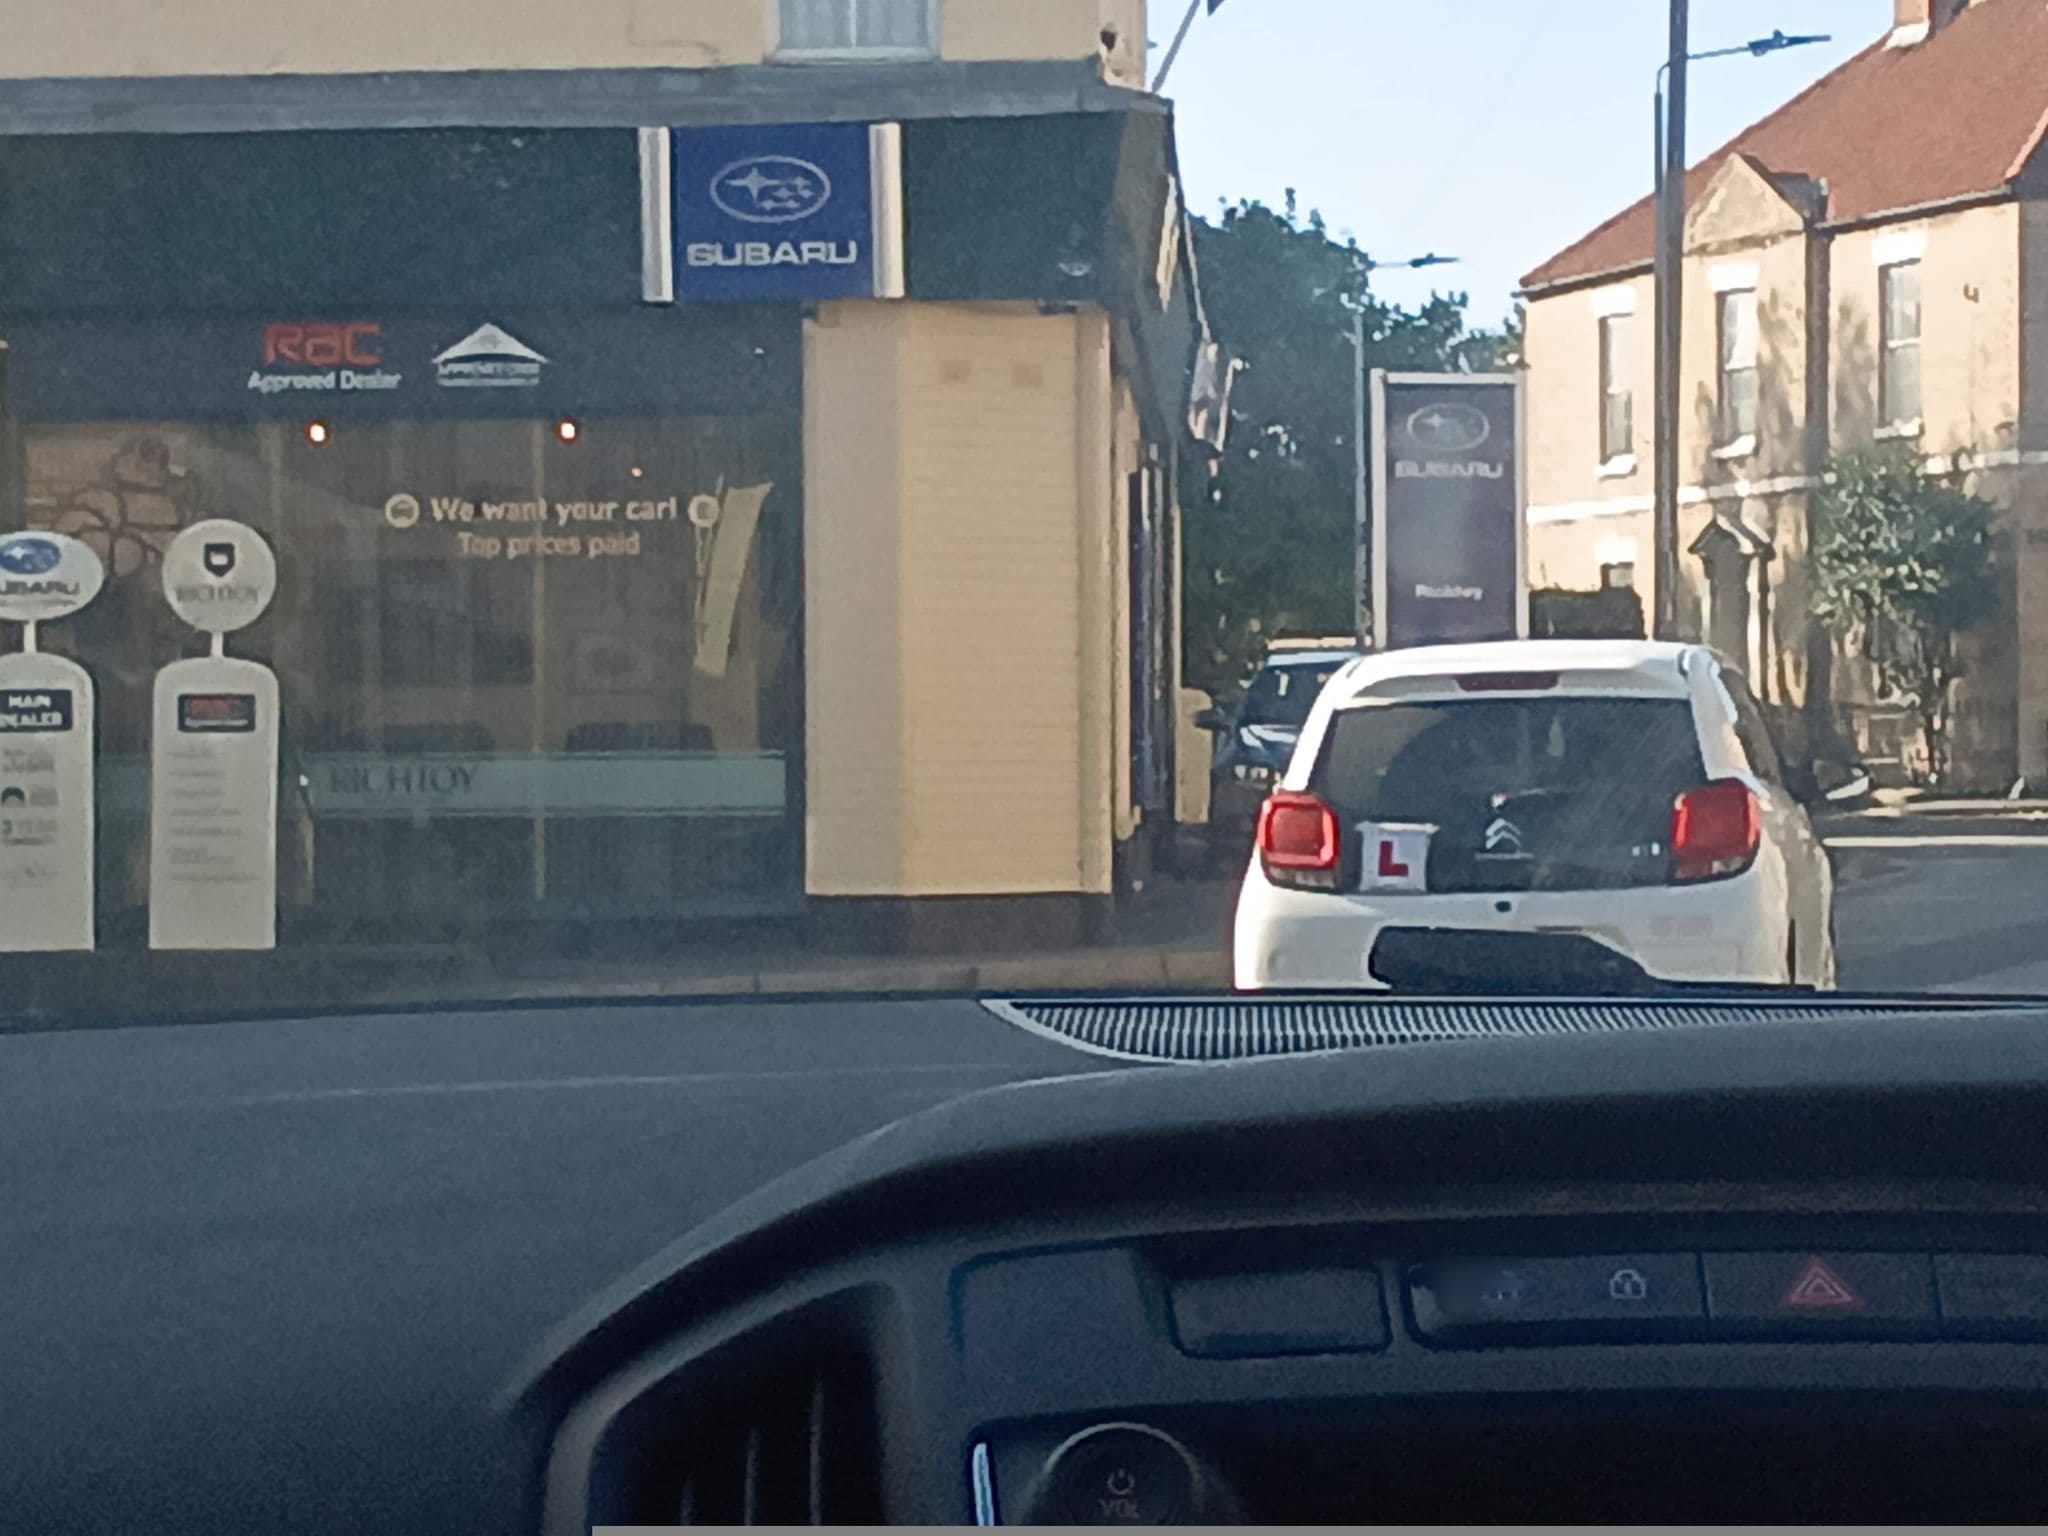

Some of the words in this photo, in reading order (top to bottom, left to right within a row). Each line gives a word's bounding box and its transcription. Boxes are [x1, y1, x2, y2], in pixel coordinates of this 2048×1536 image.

[687, 240, 858, 266] SUBARU
[248, 371, 335, 393] Approved
[340, 370, 402, 390] Dealer
[1394, 460, 1504, 479] SUBARU
[430, 497, 475, 522] We
[481, 497, 548, 521] want
[555, 500, 619, 526] your
[458, 531, 500, 558] Top
[508, 533, 581, 559] prices
[588, 531, 641, 558] paid
[0, 580, 80, 595] UBARU
[9, 694, 51, 709] MAIN
[1378, 841, 1409, 876] L
